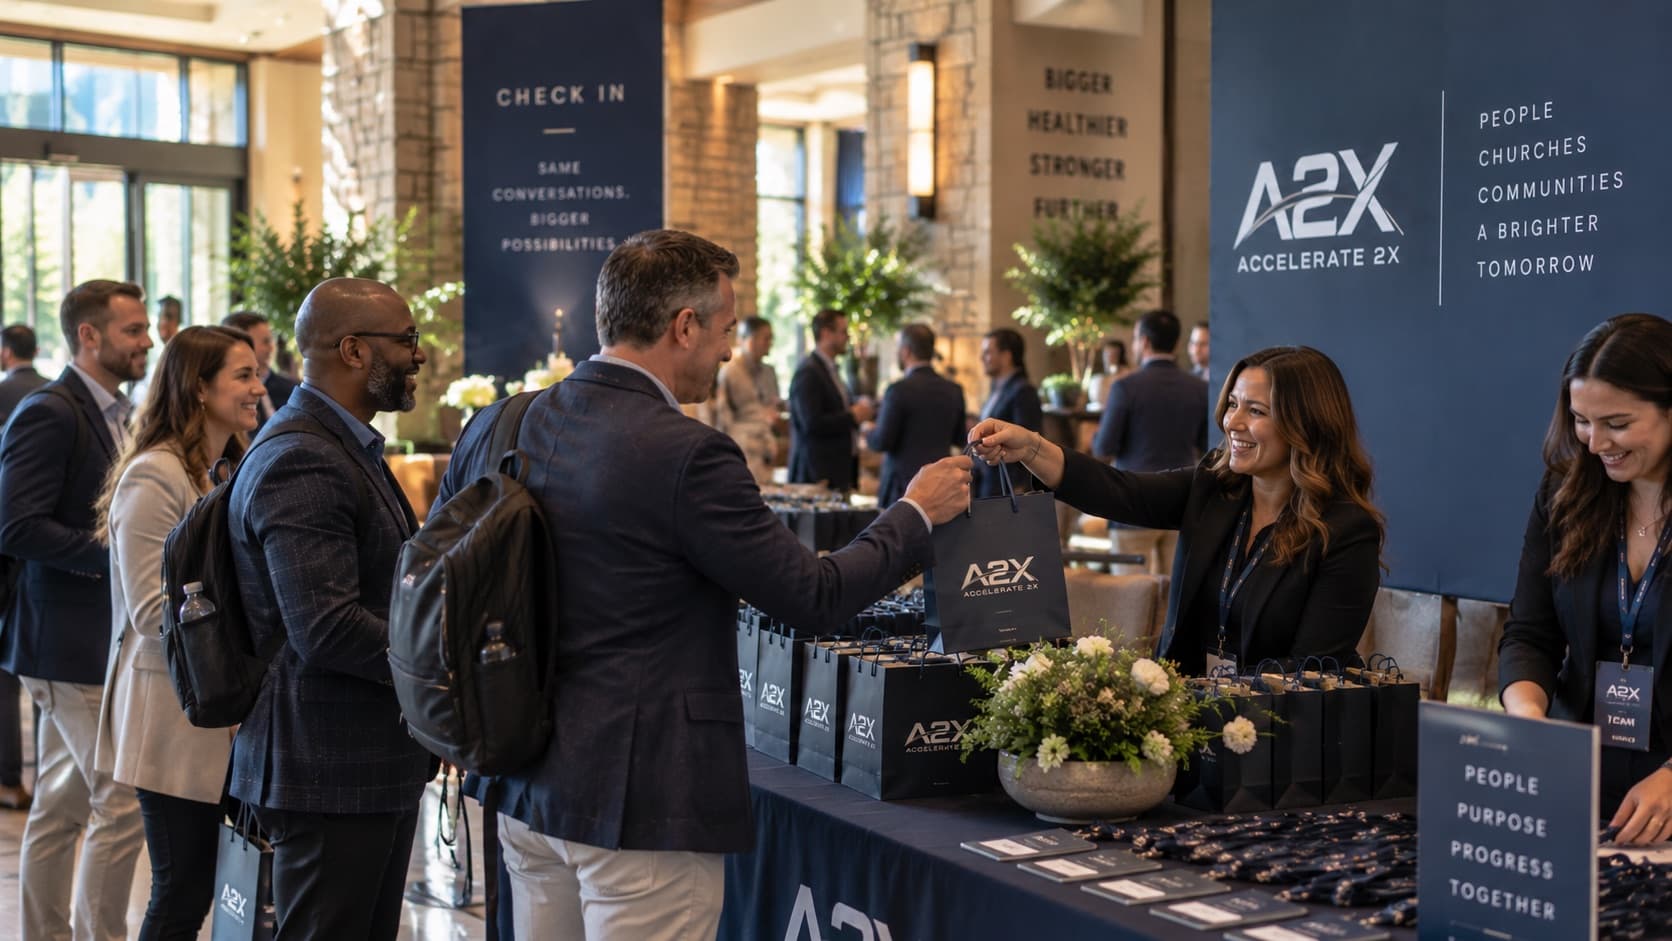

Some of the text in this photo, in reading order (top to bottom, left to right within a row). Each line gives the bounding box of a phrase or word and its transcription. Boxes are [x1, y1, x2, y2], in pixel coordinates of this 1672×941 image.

[496, 83, 625, 106] CHECK IN
[1045, 67, 1112, 94] BIGGER
[1027, 109, 1128, 138] HEALTHIER
[1480, 101, 1553, 129] PEOPLE
[1479, 135, 1586, 167] CHURCHES
[538, 160, 581, 175] SAME
[1030, 153, 1125, 181] STRONGER
[1233, 141, 1404, 250] A2X
[1478, 171, 1623, 204] COMMUNITIES
[530, 212, 590, 227] BIGGER
[1477, 214, 1599, 241] A BRIGHTER
[1237, 245, 1400, 273] ACCELERATE 2X
[1477, 254, 1595, 278] TOMORROW
[961, 556, 1039, 591] A2X
[963, 584, 1024, 598] ACCELERATE
[760, 682, 785, 709] A2X
[1606, 684, 1640, 702] A2X
[804, 697, 830, 725] A2X
[847, 712, 875, 741] A2X
[1464, 764, 1539, 796] PEOPLE
[1457, 802, 1547, 838] PURPOSE
[1451, 840, 1553, 880] PROGRESS
[221, 883, 247, 918] A2X
[1449, 878, 1555, 921] TOGETHER
